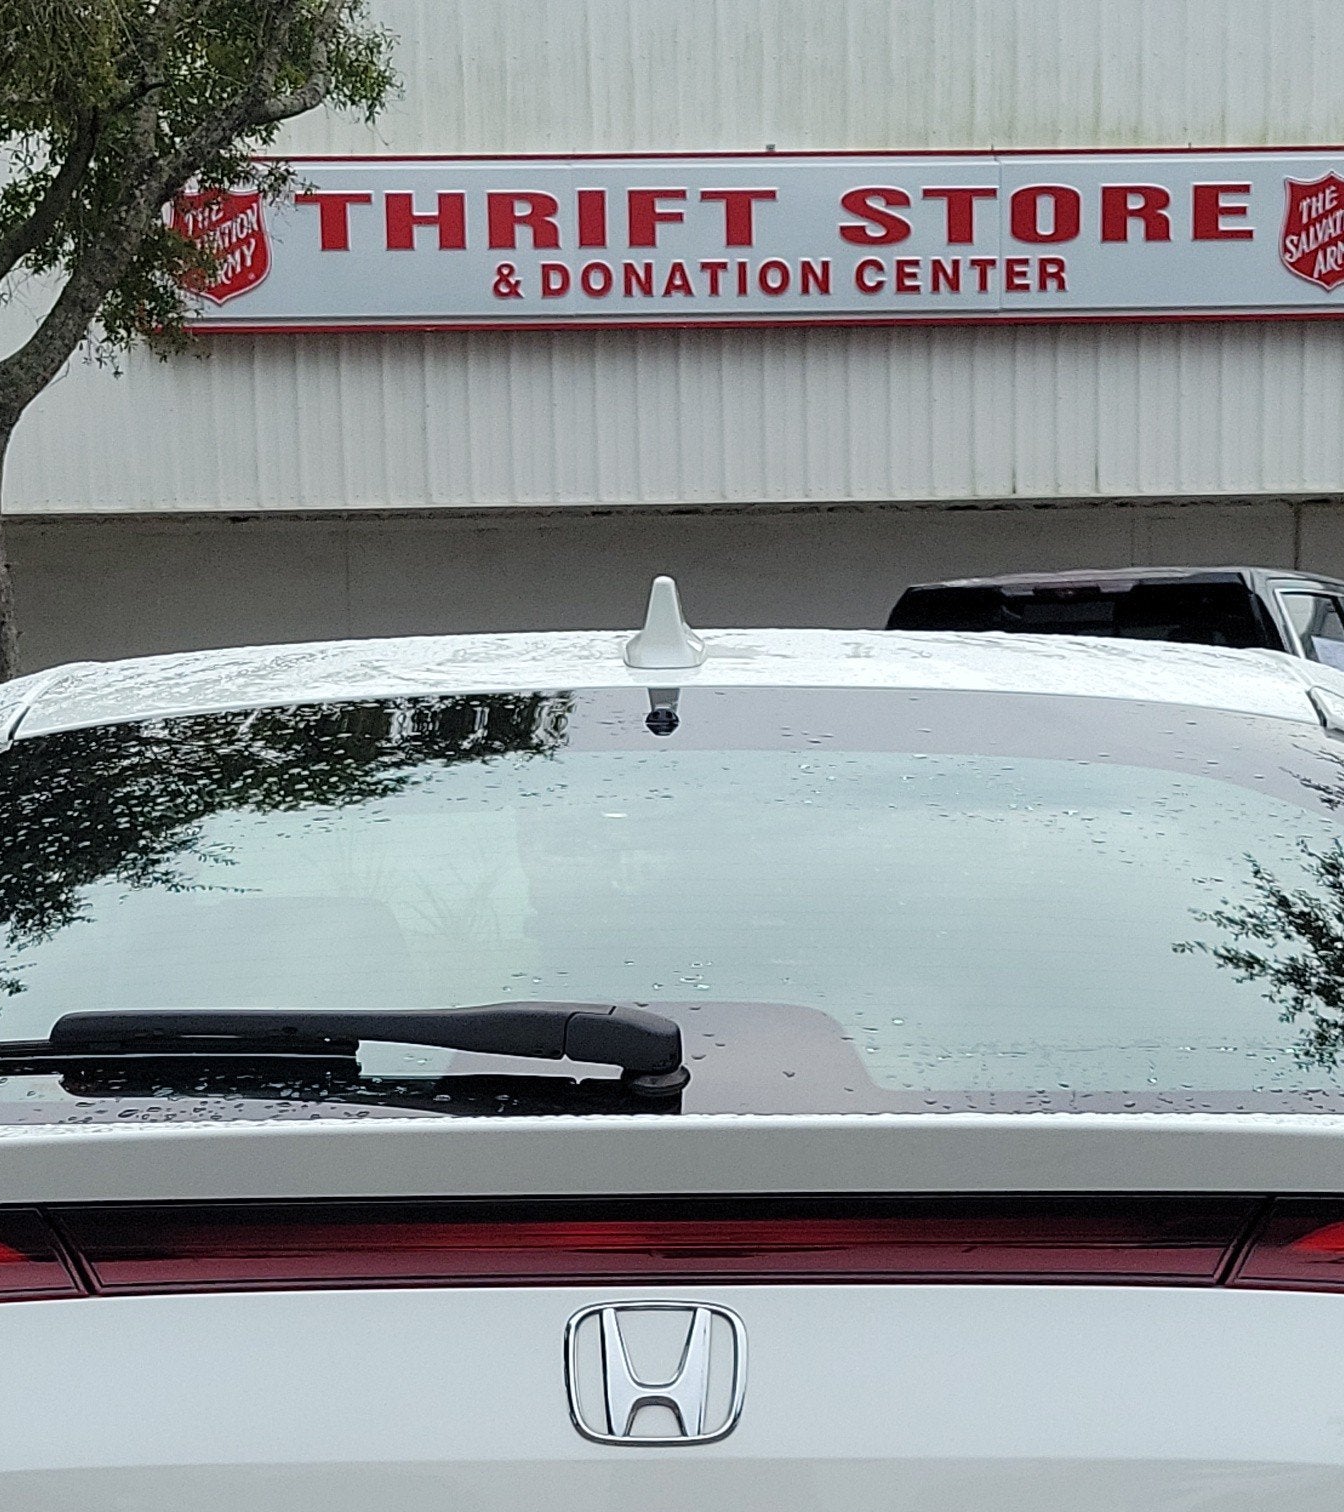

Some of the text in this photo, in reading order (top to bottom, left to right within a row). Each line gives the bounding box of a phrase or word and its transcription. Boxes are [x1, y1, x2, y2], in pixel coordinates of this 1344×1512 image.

[294, 182, 1255, 252] THRIFT STORE
[1299, 185, 1340, 225] THE
[492, 256, 1068, 299] & DONATION CENTER
